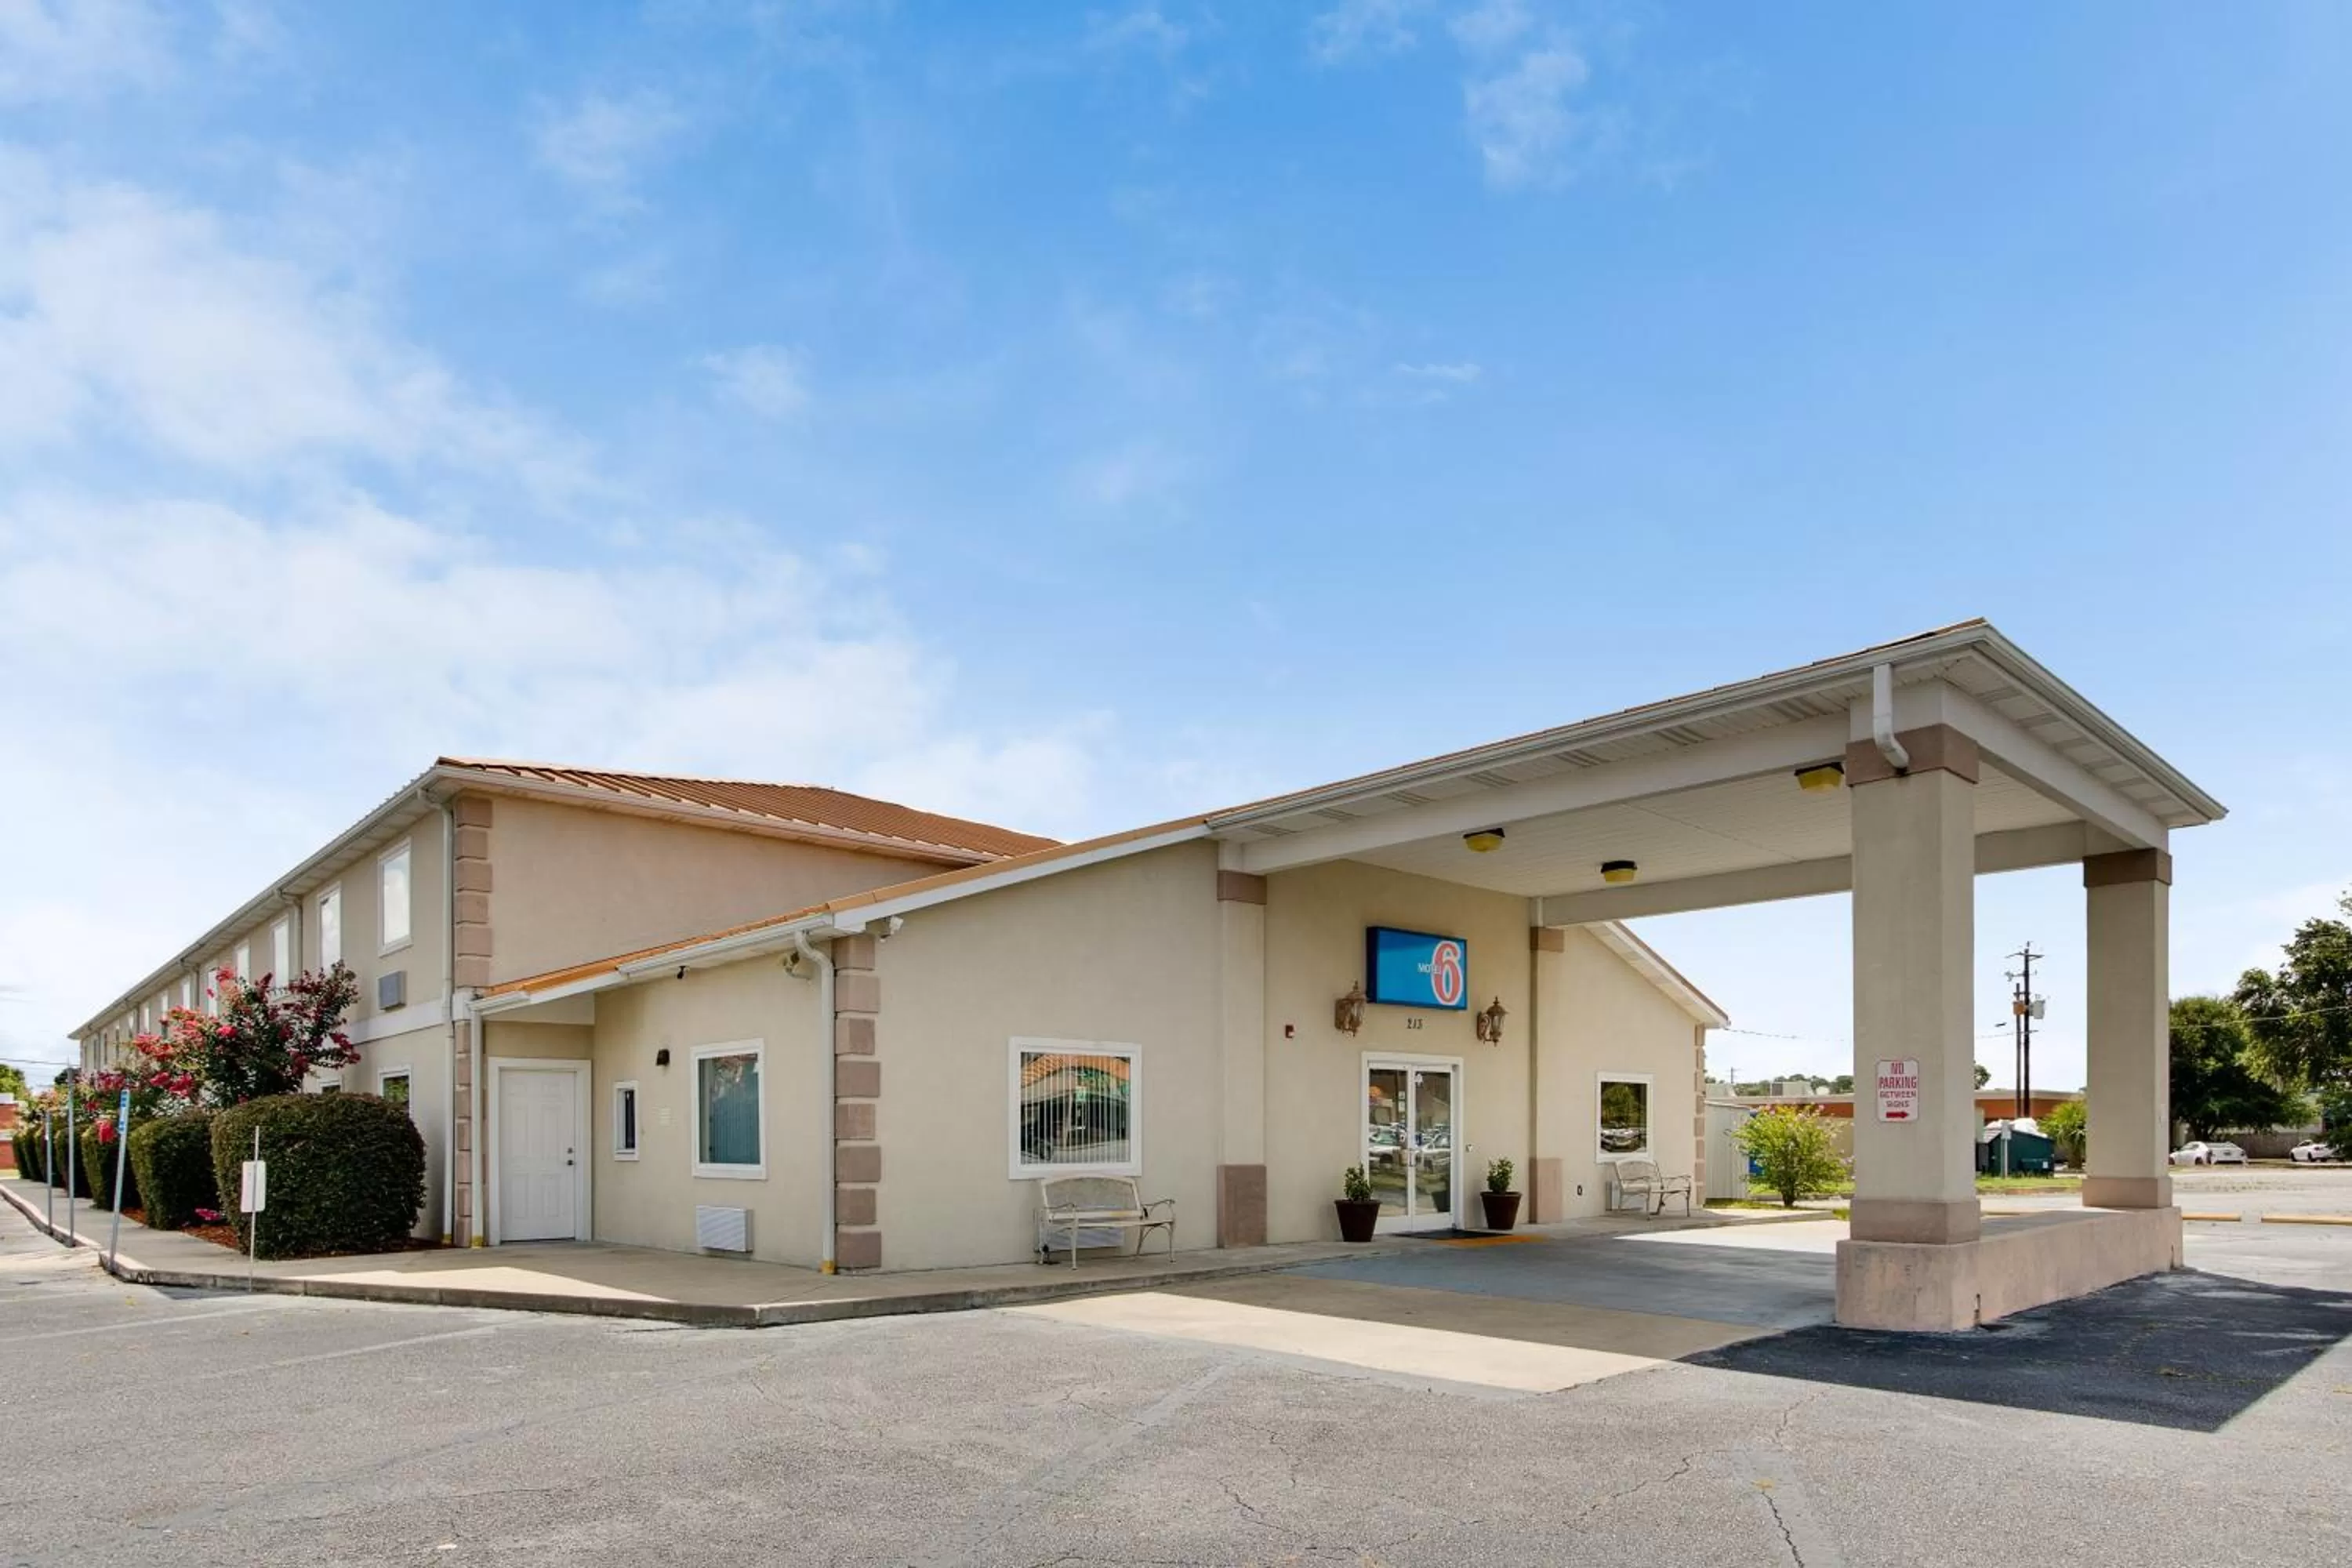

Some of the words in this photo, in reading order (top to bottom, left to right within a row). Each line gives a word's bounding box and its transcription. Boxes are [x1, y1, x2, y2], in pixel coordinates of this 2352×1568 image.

[1431, 940, 1463, 1005] 6
[1890, 1062, 1904, 1074] NO
[1878, 1076, 1917, 1088] PARKING
